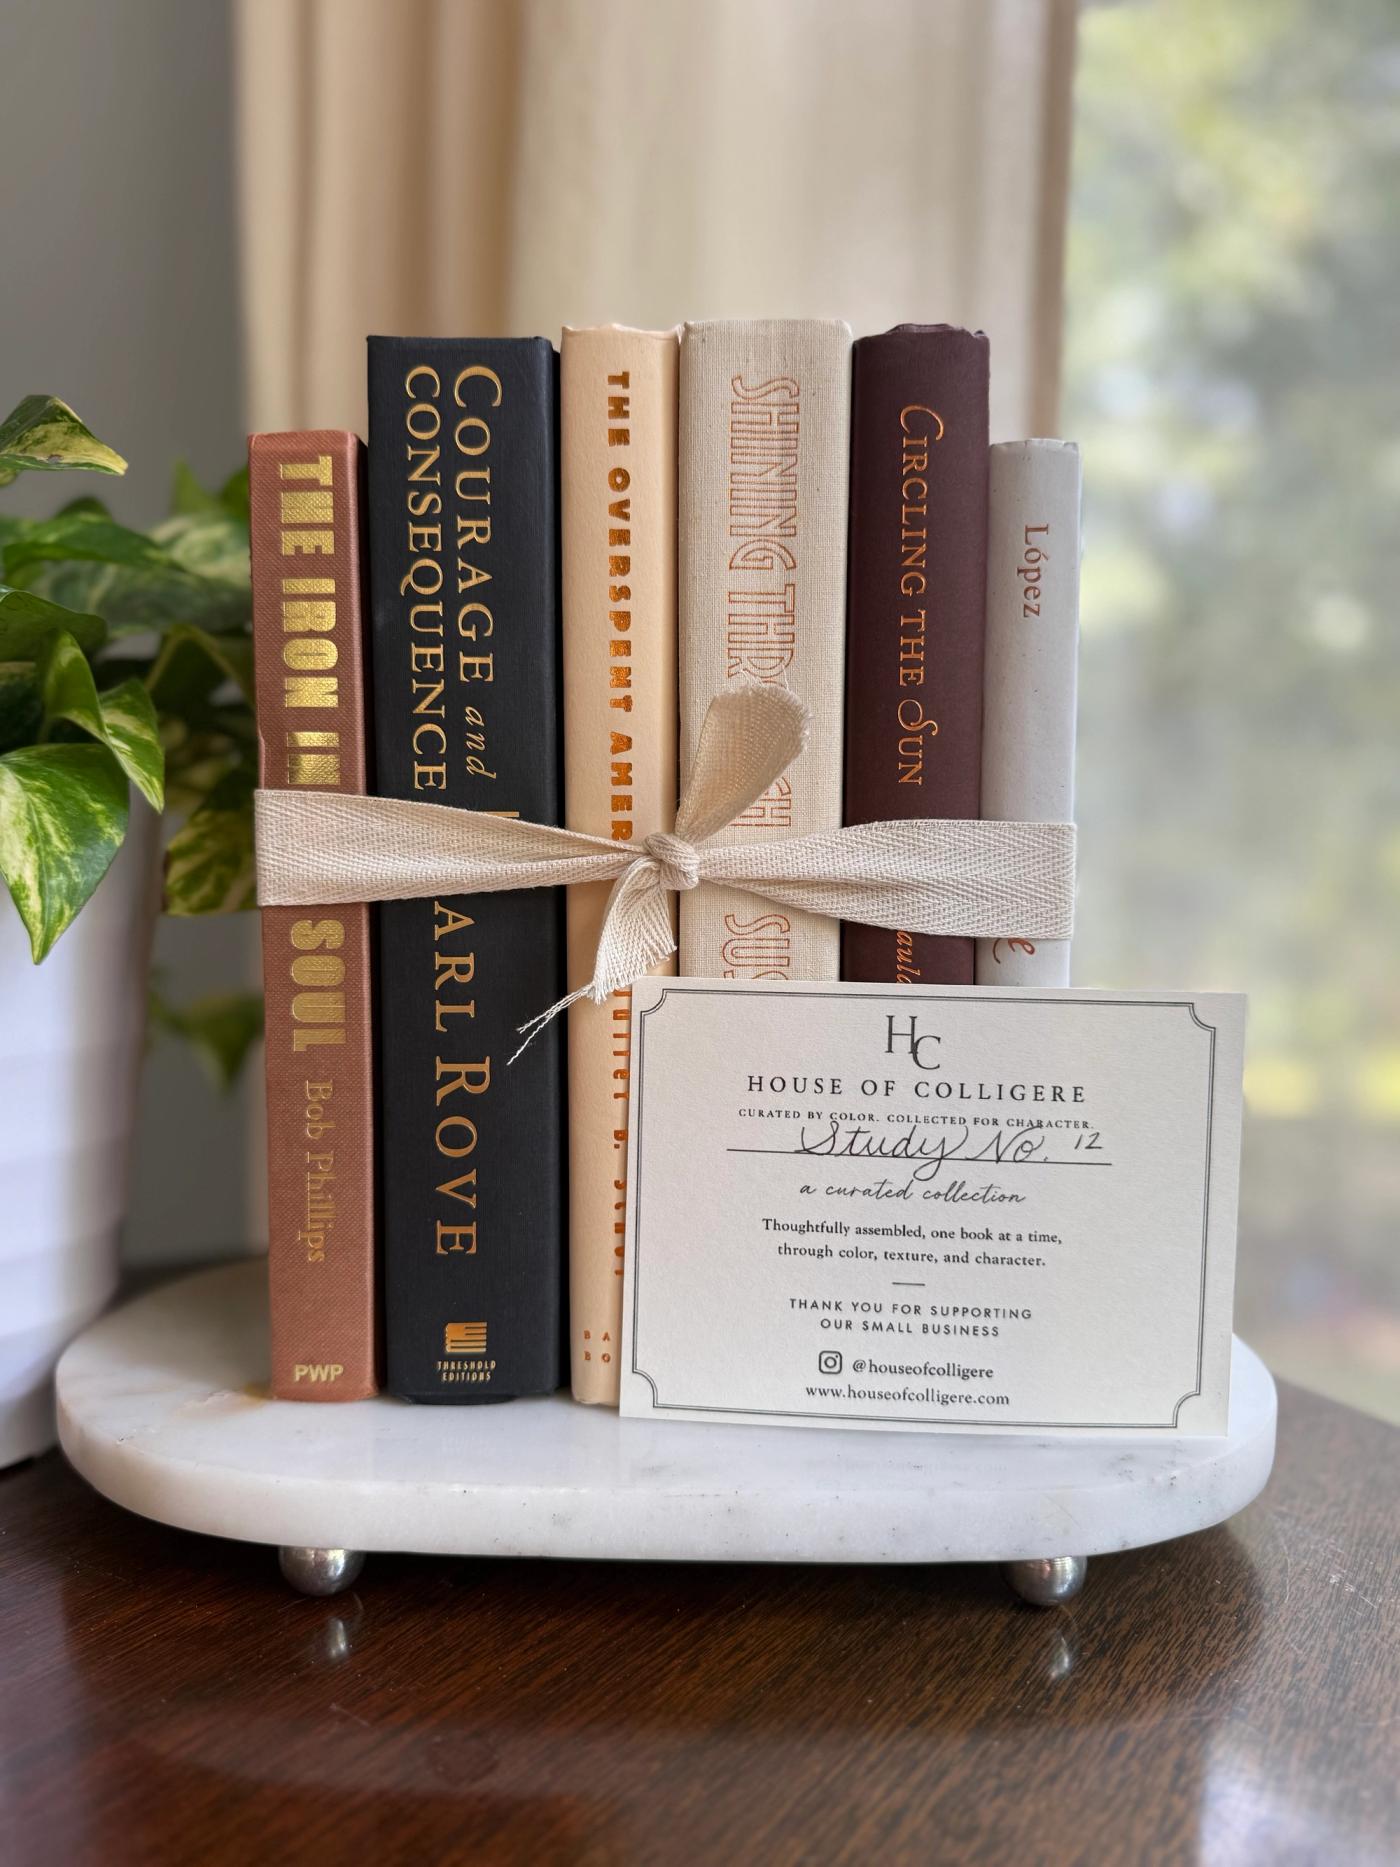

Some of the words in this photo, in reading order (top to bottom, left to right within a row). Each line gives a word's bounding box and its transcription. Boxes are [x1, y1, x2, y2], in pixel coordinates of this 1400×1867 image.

[607, 371, 630, 447] THE
[728, 376, 801, 571] SHINING
[900, 404, 944, 597] CIRCLING
[280, 456, 334, 555] THE
[453, 366, 502, 683] COURAGE
[401, 366, 447, 791] CONSEQUENCE
[608, 467, 632, 713] OVERSPENT
[1017, 523, 1049, 618] López
[283, 579, 339, 708] IRON
[899, 609, 926, 687] THE
[287, 732, 341, 784] IN
[465, 706, 497, 780] and
[897, 699, 938, 786] SUN
[722, 913, 790, 979] SU
[291, 920, 346, 1051] SOUL
[885, 1015, 941, 1070] HC
[306, 1080, 336, 1140] Bob
[738, 1108, 801, 1119] CURATED
[807, 1110, 823, 1120] BY
[829, 1112, 880, 1122] COLOR.
[887, 1114, 967, 1125] COLLECTED
[973, 1117, 1000, 1126] FOR
[1006, 1119, 1094, 1130] CHARACTER.
[748, 1076, 843, 1094] HOUSE
[861, 1080, 896, 1096] OF
[914, 1082, 1085, 1102] COLLIGERE
[435, 1056, 491, 1255] ROVE
[795, 1121, 968, 1181] Study
[1074, 1132, 1103, 1149] 12
[298, 1150, 337, 1263] Phillips
[800, 1184, 817, 1195] a
[825, 1180, 914, 1200] curated
[923, 1181, 1027, 1204] collection
[762, 1218, 851, 1237] Thoughtfully
[855, 1224, 926, 1240] assembled,
[930, 1231, 955, 1240] one
[960, 1227, 993, 1241] book
[998, 1231, 1011, 1241] at
[1015, 1234, 1023, 1242] a
[1028, 1230, 1063, 1245] time,
[777, 1242, 834, 1259] through
[838, 1246, 878, 1262] color,
[884, 1251, 939, 1264] texture,
[943, 1250, 970, 1264] and
[975, 1252, 1046, 1267] character.
[789, 1298, 843, 1312] THANK
[851, 1301, 883, 1313] YOU
[892, 1303, 922, 1316] FOR
[930, 1305, 1033, 1320] SUPPORTING
[820, 1318, 853, 1331] OUR
[862, 1321, 913, 1334] SMALL
[922, 1323, 1000, 1338] BUSINESS
[294, 1364, 345, 1383] PWP
[437, 1359, 497, 1371] THRESHOLD
[442, 1371, 491, 1382] EDITIONS
[805, 1383, 1010, 1407] www.houseofcolligere.com
[852, 1358, 994, 1381] @houseofcolligere
